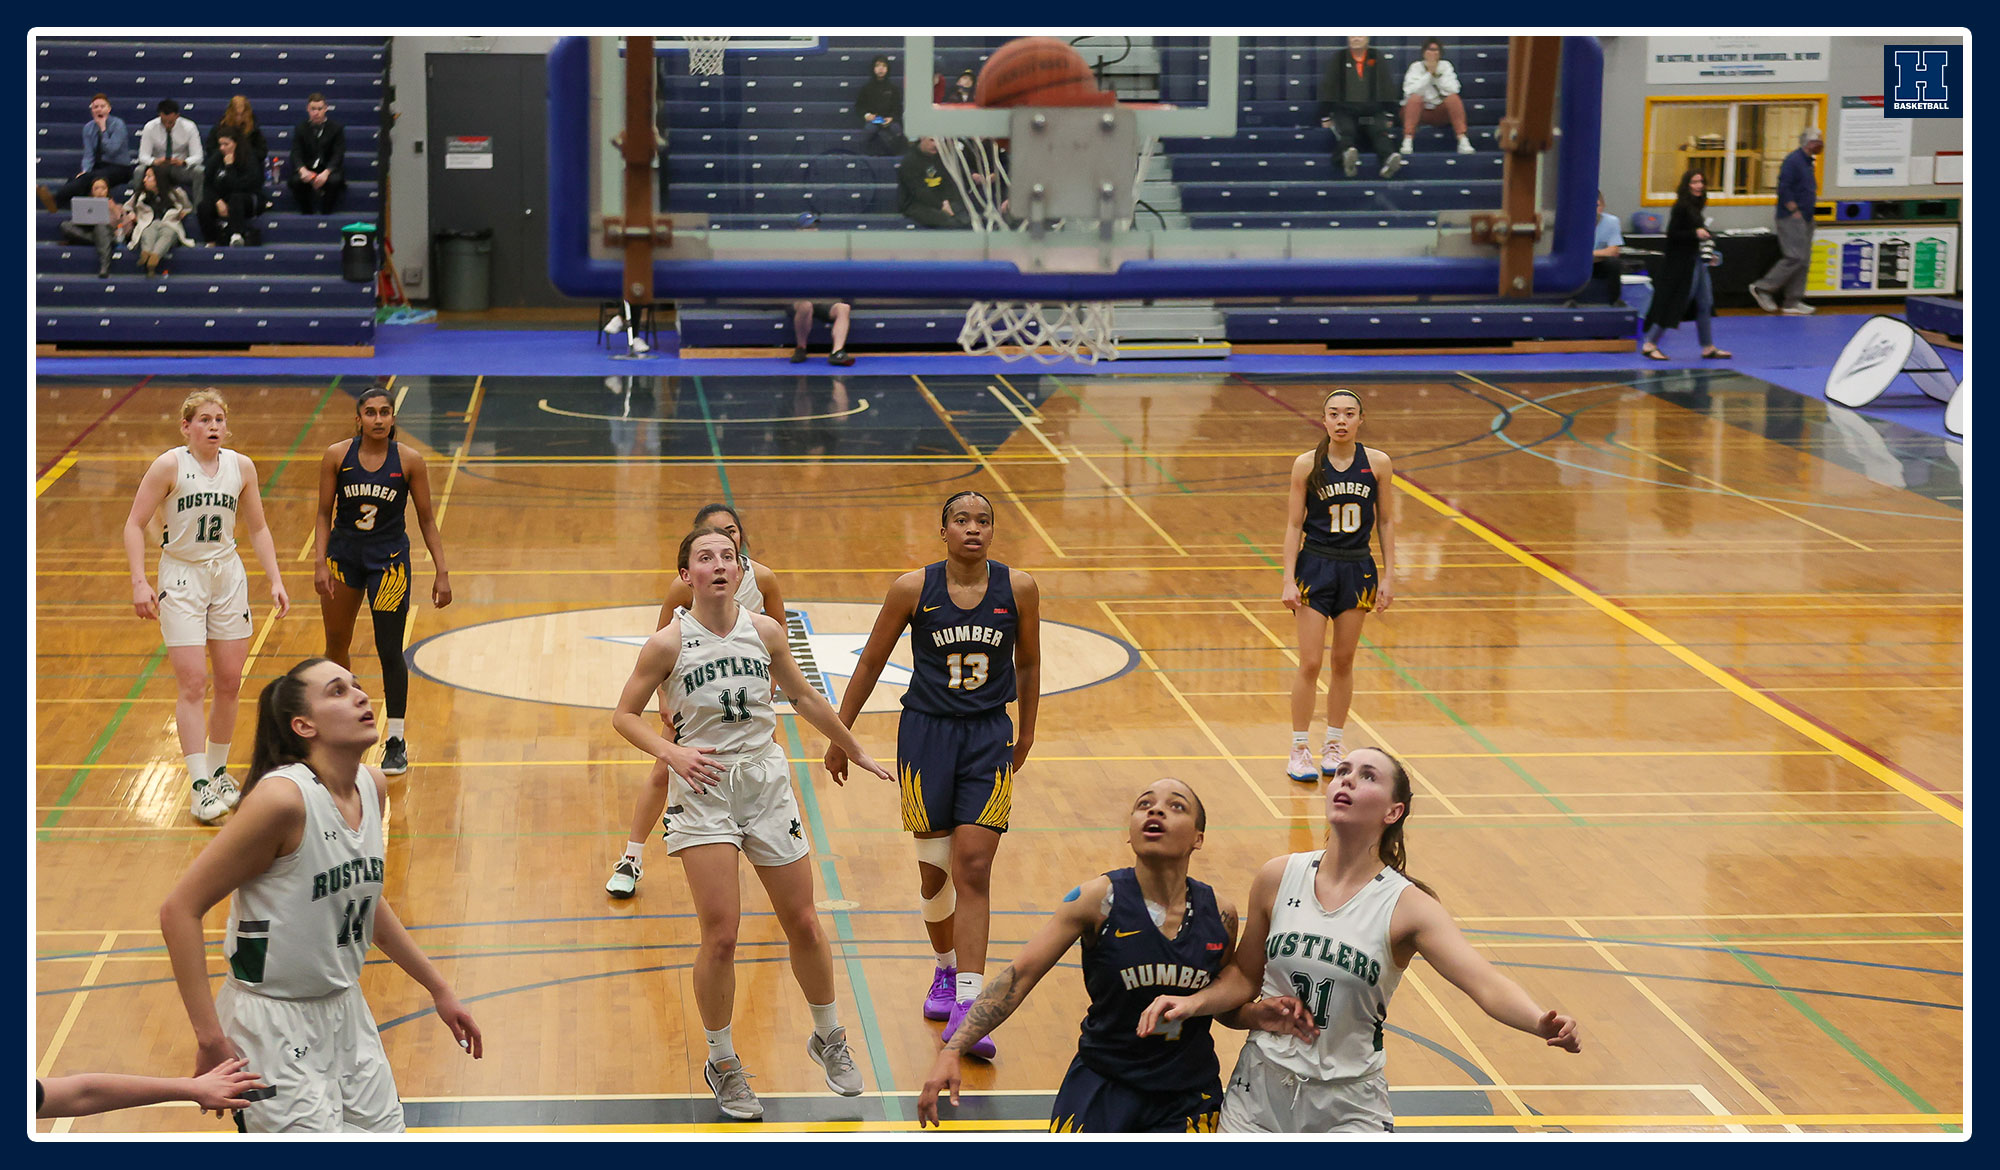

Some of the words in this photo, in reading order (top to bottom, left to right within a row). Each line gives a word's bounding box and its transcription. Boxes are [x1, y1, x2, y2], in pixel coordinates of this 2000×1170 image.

[177, 492, 237, 514] RUSTLER
[343, 483, 398, 503] HUMBER
[195, 513, 223, 543] 12
[354, 503, 379, 531] 3
[1328, 502, 1362, 533] 10
[931, 624, 1004, 648] HUMBER
[682, 656, 770, 697] RUSTLERS
[946, 652, 990, 691] 13
[718, 686, 753, 724] 11
[1265, 930, 1381, 988] USTLERS
